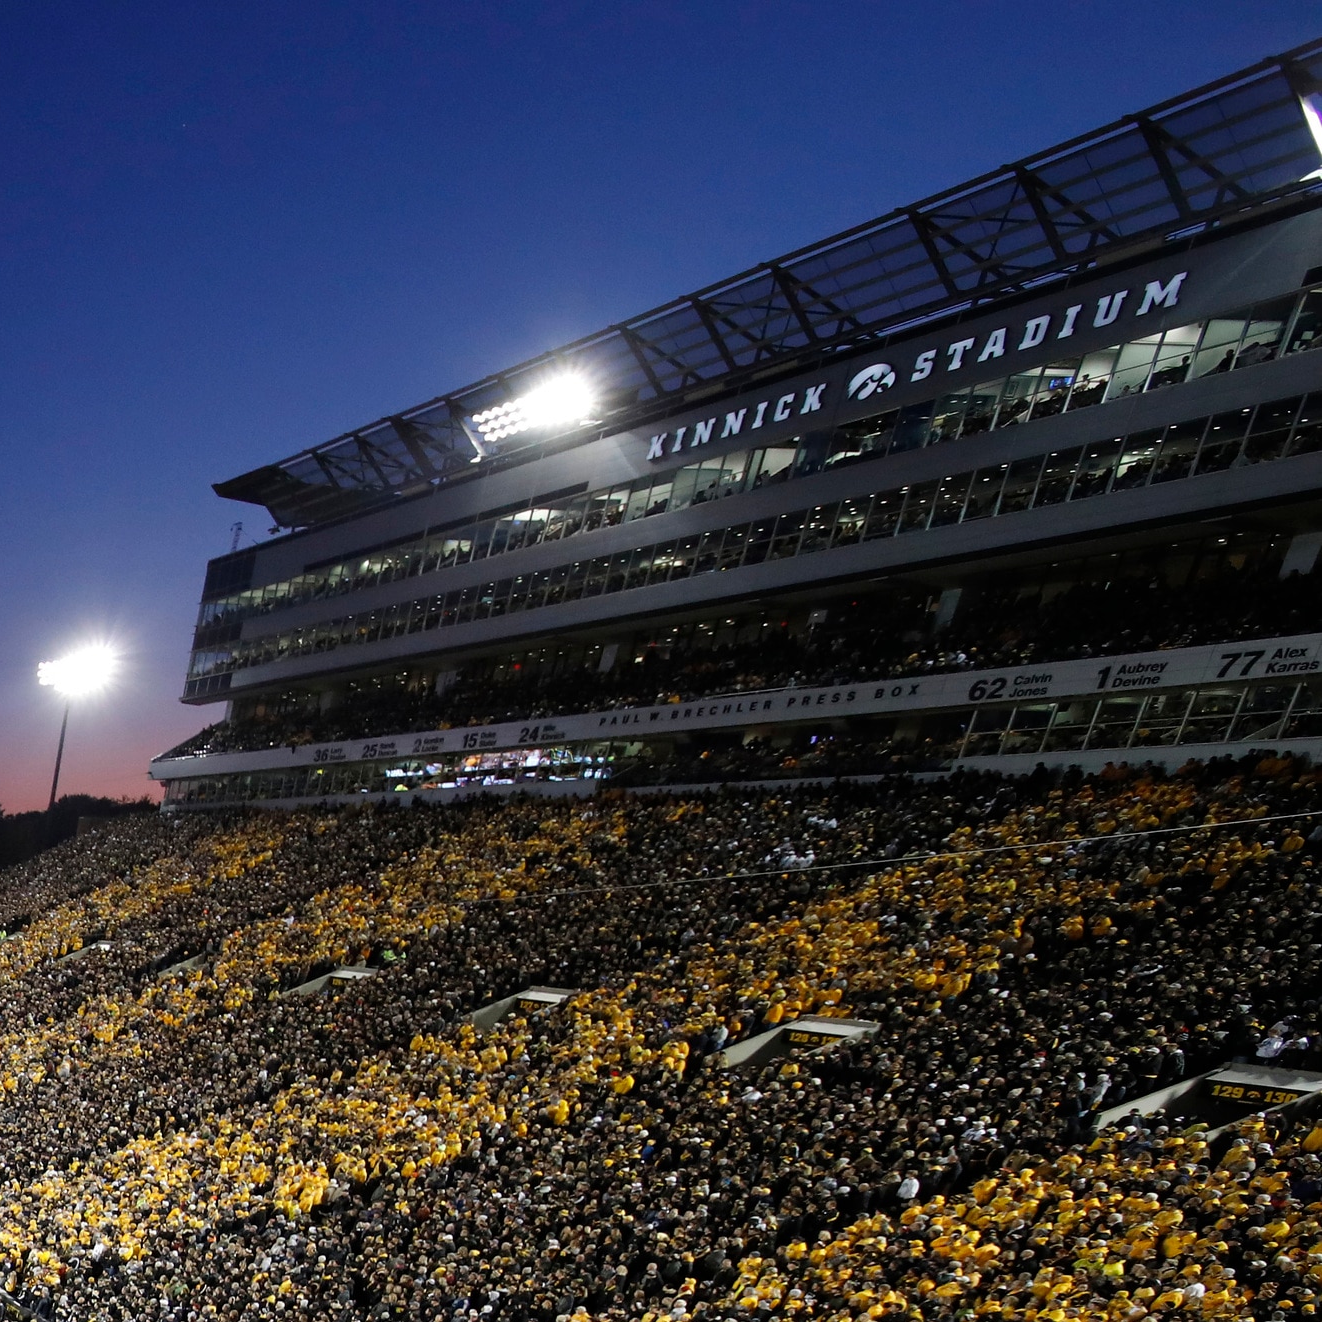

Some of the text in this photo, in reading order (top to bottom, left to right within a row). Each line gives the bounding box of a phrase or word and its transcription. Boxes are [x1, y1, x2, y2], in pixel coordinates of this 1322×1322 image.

[646, 271, 1189, 461] KINNICK STADIUM
[1271, 646, 1308, 660] Alex
[1116, 660, 1168, 676] Aubrey
[1216, 649, 1266, 678] 77
[1264, 659, 1320, 675] Karras
[1013, 672, 1053, 686] Calvin
[1097, 665, 1112, 689] 1
[1111, 674, 1161, 689] Devine
[968, 677, 1007, 700] 62
[1008, 685, 1049, 699] Jones
[599, 711, 640, 727] PAUL
[670, 700, 772, 720] BRECHLER
[787, 691, 857, 708] PRESS
[874, 684, 920, 699] BOX
[462, 733, 478, 748] 15
[519, 726, 539, 743] 24
[313, 749, 329, 763] 36
[362, 743, 378, 759] 25
[1211, 1084, 1245, 1099] 129
